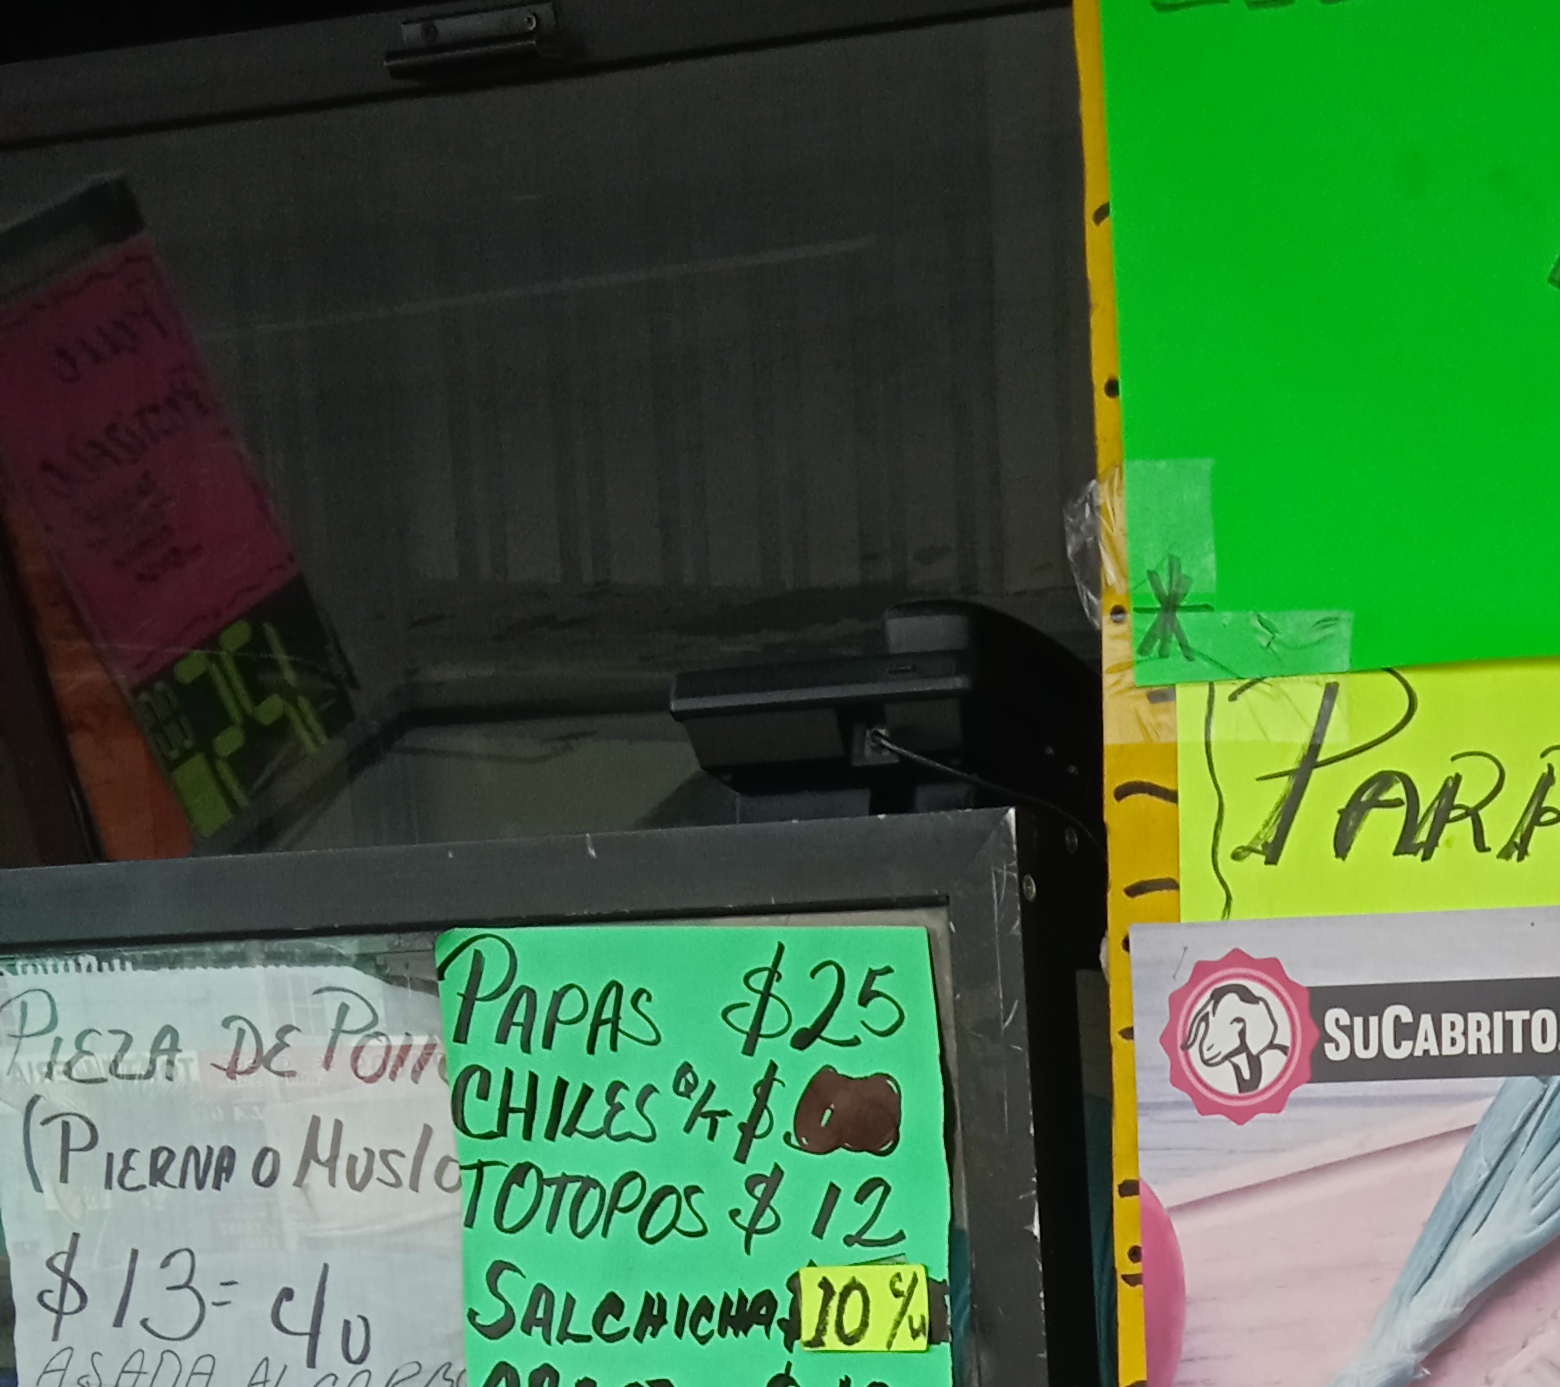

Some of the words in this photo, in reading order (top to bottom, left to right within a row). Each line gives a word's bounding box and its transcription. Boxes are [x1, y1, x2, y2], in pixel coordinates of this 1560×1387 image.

[438, 934, 662, 1055] PAPAS
[721, 941, 905, 1057] $25
[210, 1015, 302, 1082] DE
[452, 1064, 661, 1143] CHILES
[460, 1159, 709, 1246] TOTOPOS
[467, 1259, 780, 1344] SALCHICHA
